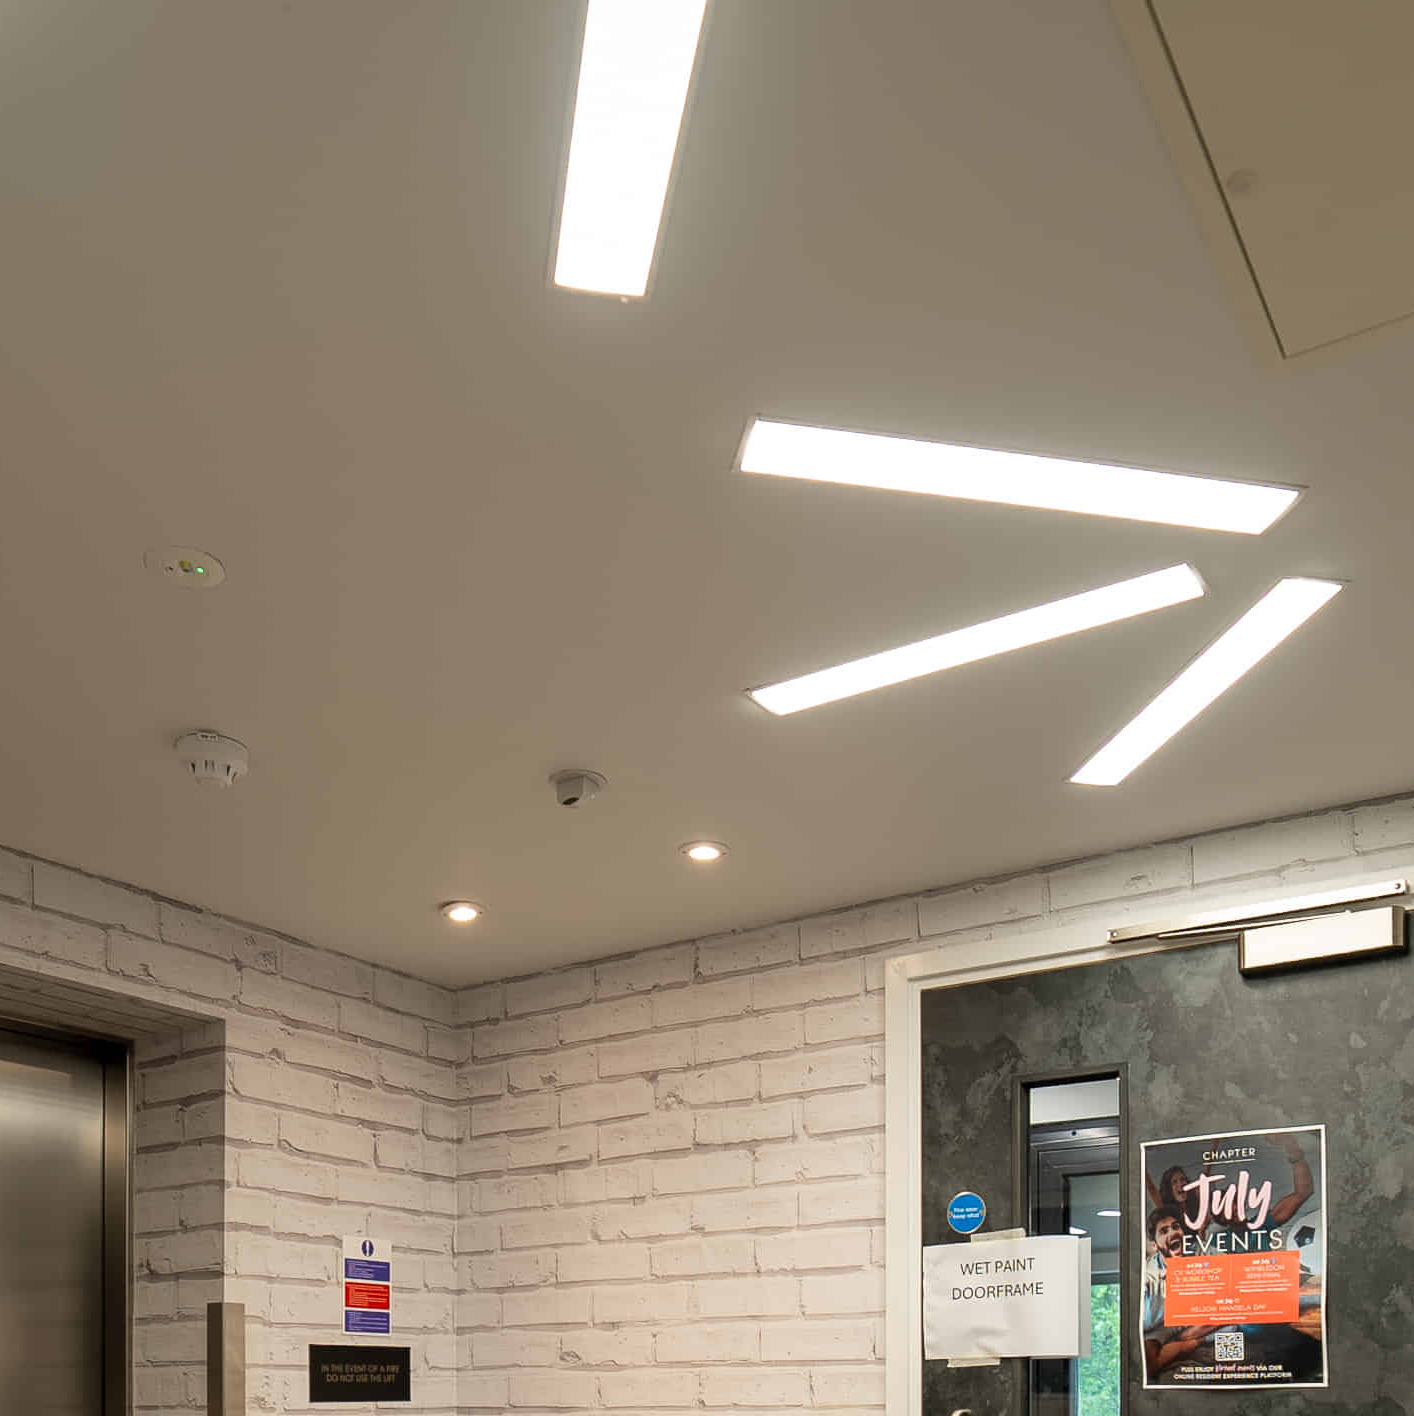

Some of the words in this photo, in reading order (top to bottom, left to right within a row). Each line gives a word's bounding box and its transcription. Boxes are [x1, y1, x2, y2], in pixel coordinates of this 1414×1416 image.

[1202, 1147, 1256, 1160] CHAPTER
[1183, 1171, 1272, 1229] July
[1182, 1229, 1283, 1254] EVENTS
[960, 1261, 992, 1276] WET
[995, 1257, 1035, 1273] PAINT
[952, 1281, 1044, 1300] DOORFRAME
